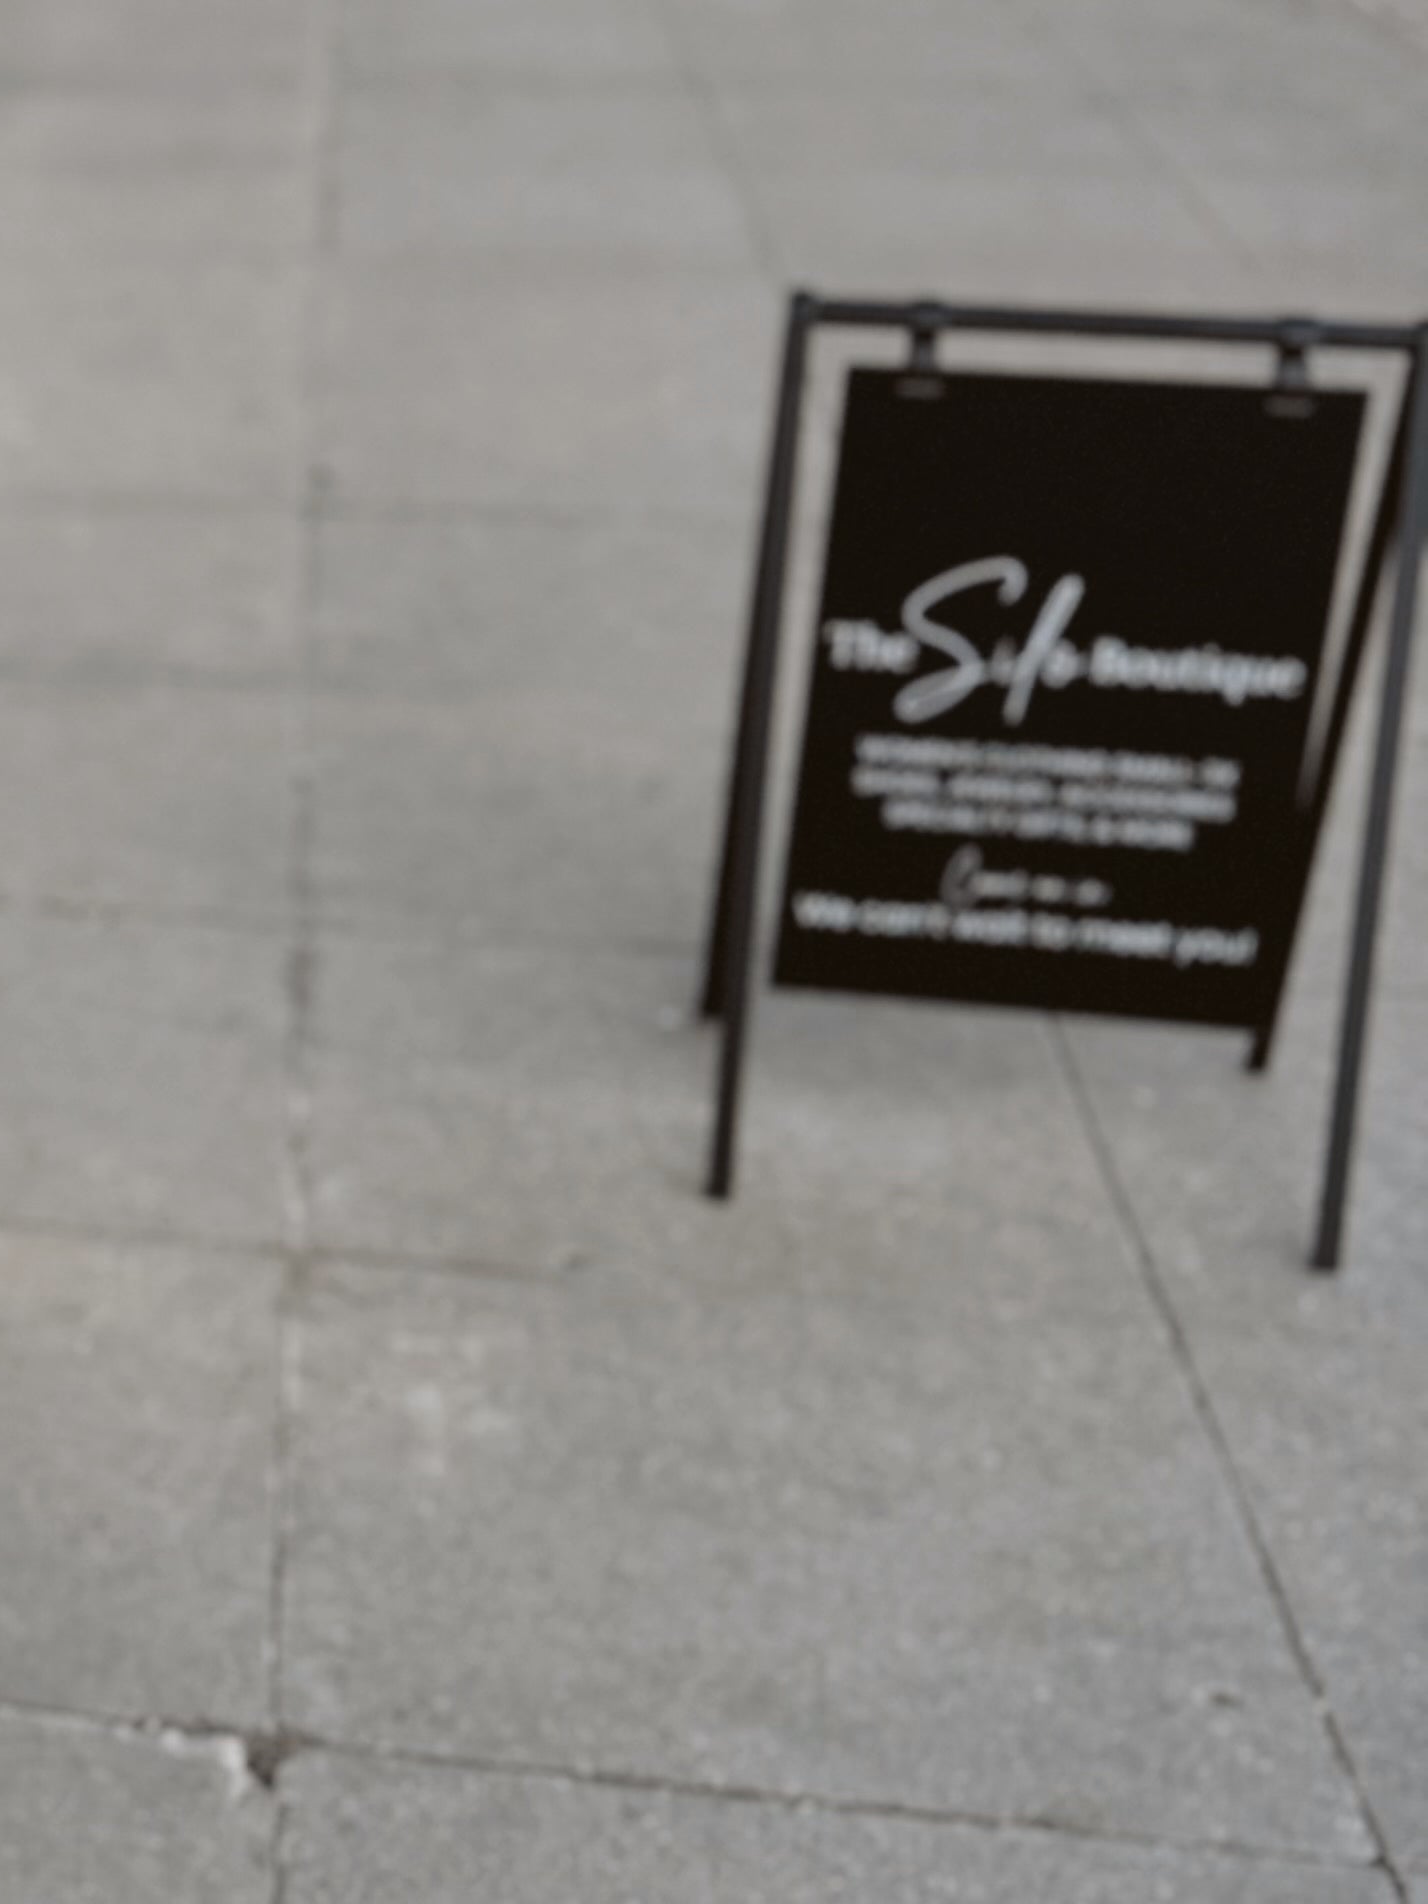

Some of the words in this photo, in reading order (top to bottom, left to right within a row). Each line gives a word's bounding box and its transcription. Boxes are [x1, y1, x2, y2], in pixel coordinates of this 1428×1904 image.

[825, 620, 917, 671] The
[1091, 637, 1305, 704] Boutique
[794, 892, 855, 930] We
[858, 899, 948, 938] can't
[952, 906, 1029, 943] wait
[1031, 914, 1072, 948] to
[1075, 920, 1172, 957] meet
[1174, 928, 1257, 967] you!
